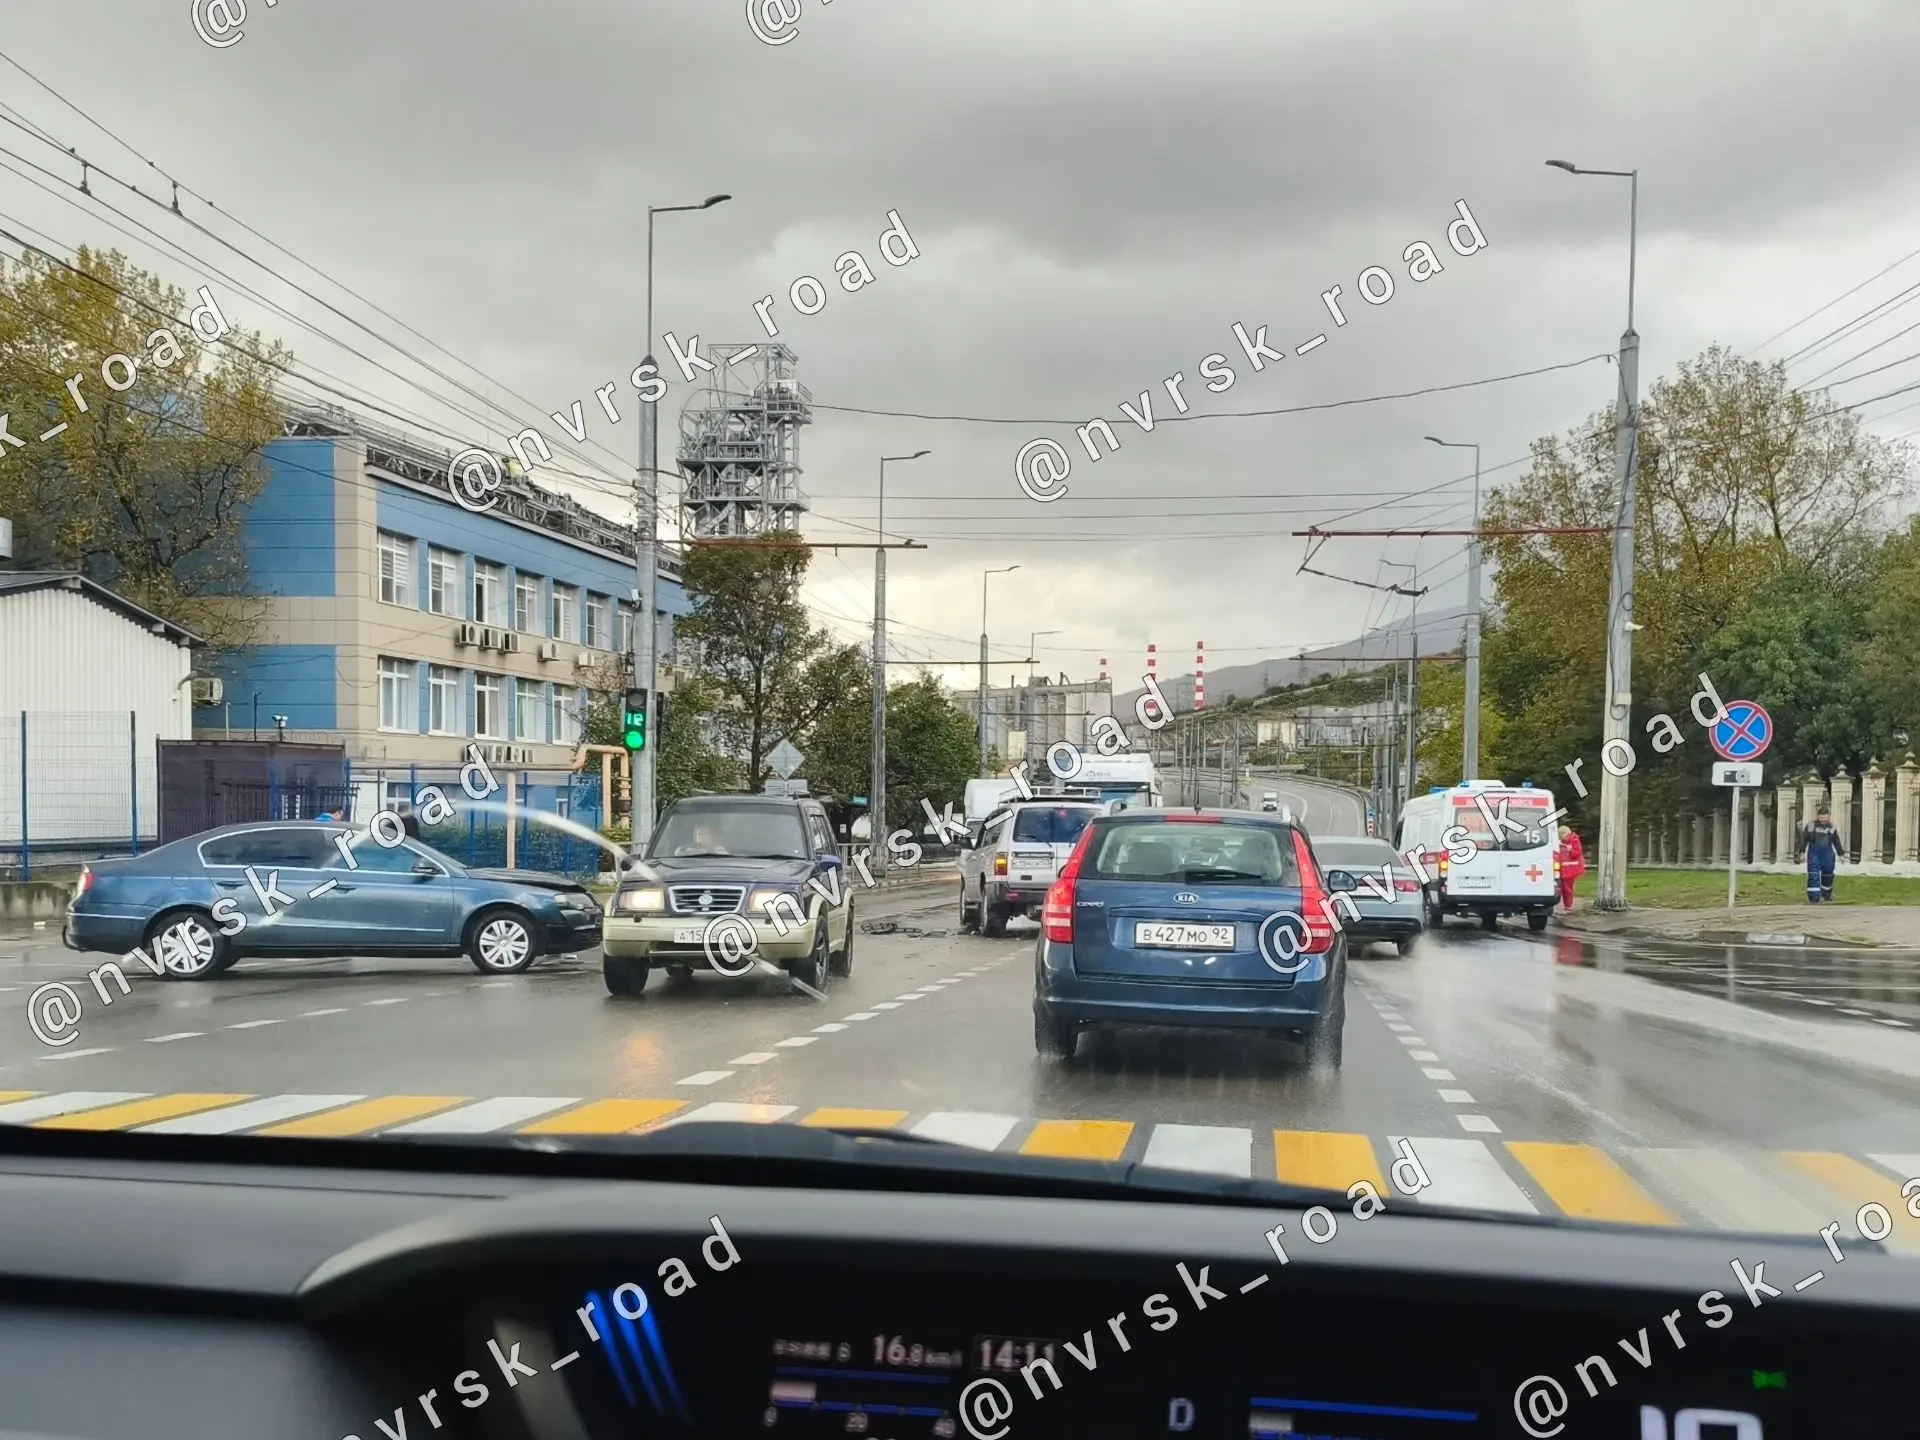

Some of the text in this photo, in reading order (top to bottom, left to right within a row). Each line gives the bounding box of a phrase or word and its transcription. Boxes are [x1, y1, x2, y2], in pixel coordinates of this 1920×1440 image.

[1523, 830, 1540, 844] 15
[1175, 894, 1196, 903] KIA
[1212, 927, 1228, 940] 92
[1168, 1397, 1194, 1431] D
